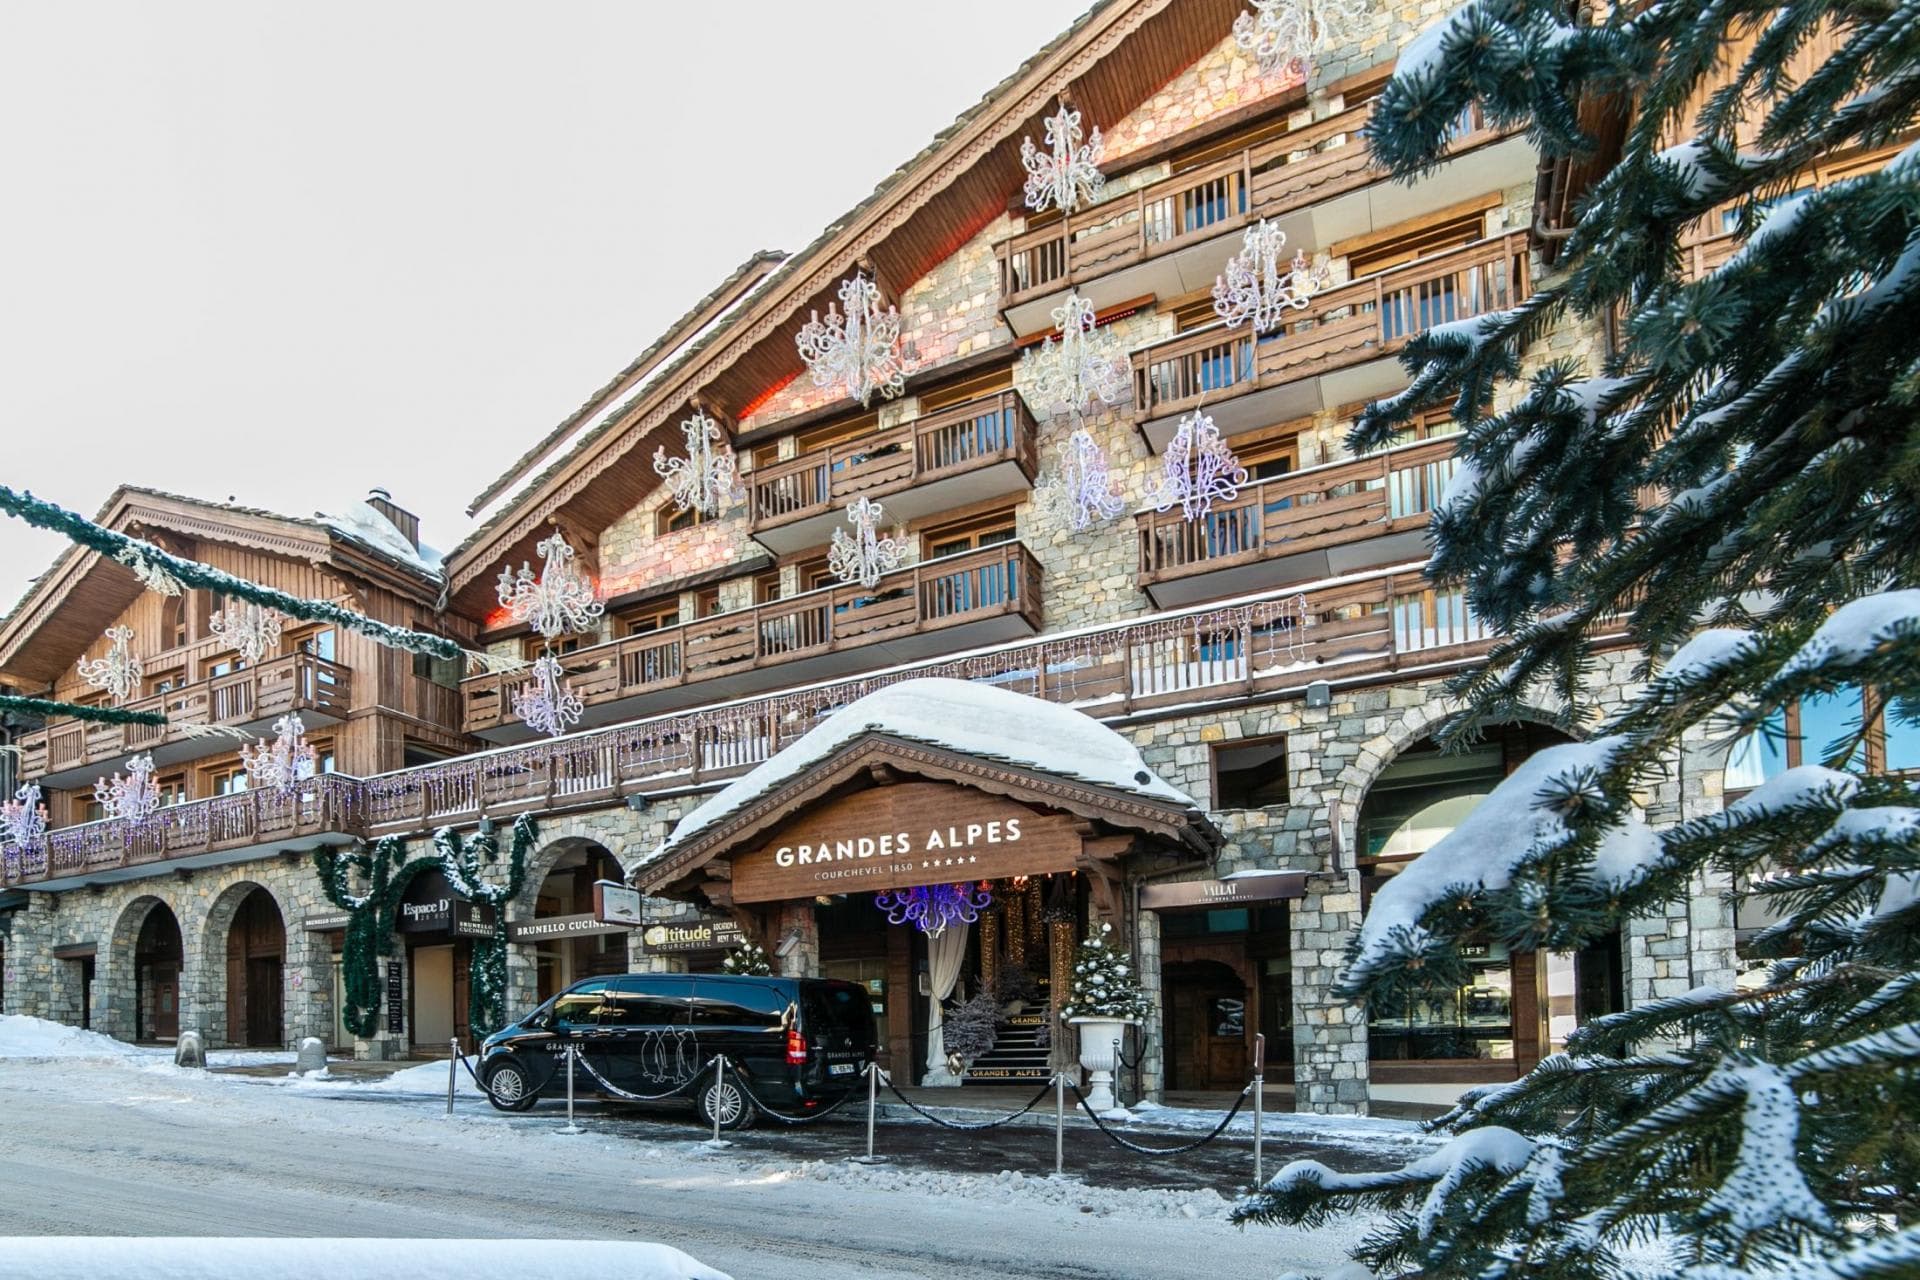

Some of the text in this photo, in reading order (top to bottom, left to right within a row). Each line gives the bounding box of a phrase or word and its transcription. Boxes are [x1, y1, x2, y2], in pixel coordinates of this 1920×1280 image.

[775, 819, 1021, 867] GRANDES ALPES
[814, 863, 913, 881] COURCHEVEL 1850
[1203, 883, 1237, 896] VALLAT
[403, 903, 437, 921] Espace
[517, 923, 565, 936] BRUNELLO
[656, 941, 711, 951] COURCHEVEL
